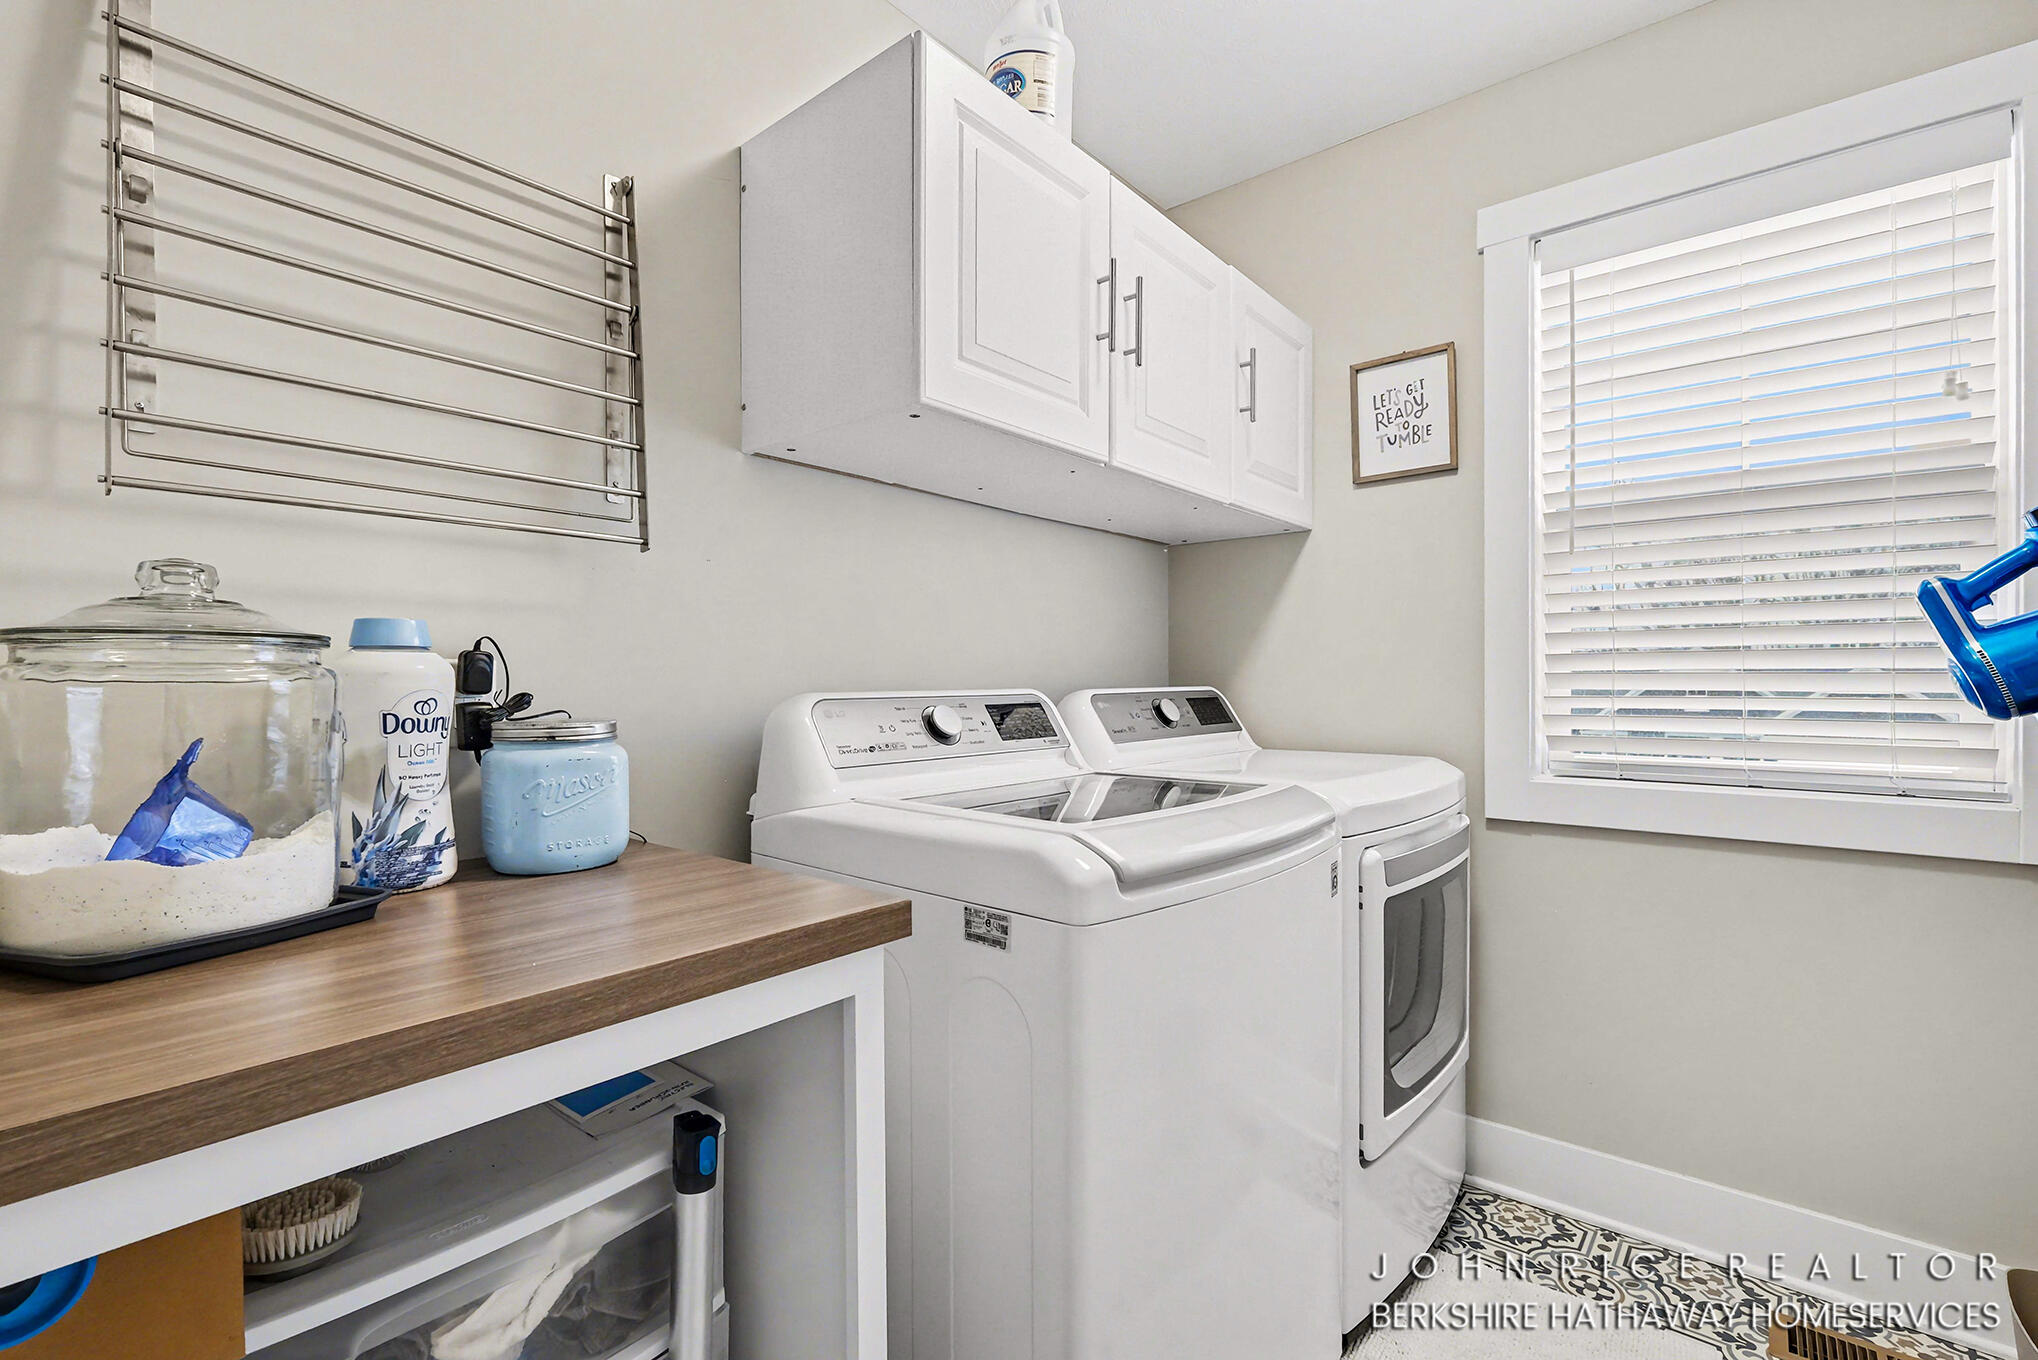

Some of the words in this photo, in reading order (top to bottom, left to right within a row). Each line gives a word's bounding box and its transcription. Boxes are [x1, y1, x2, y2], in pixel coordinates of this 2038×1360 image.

[1373, 387, 1402, 411] LET'S
[1406, 378, 1425, 396] GET
[1375, 392, 1429, 432] READY
[1394, 420, 1410, 432] TO
[1376, 424, 1432, 454] TUMBLE
[382, 712, 451, 740] Downy
[398, 741, 443, 759] LIGHT
